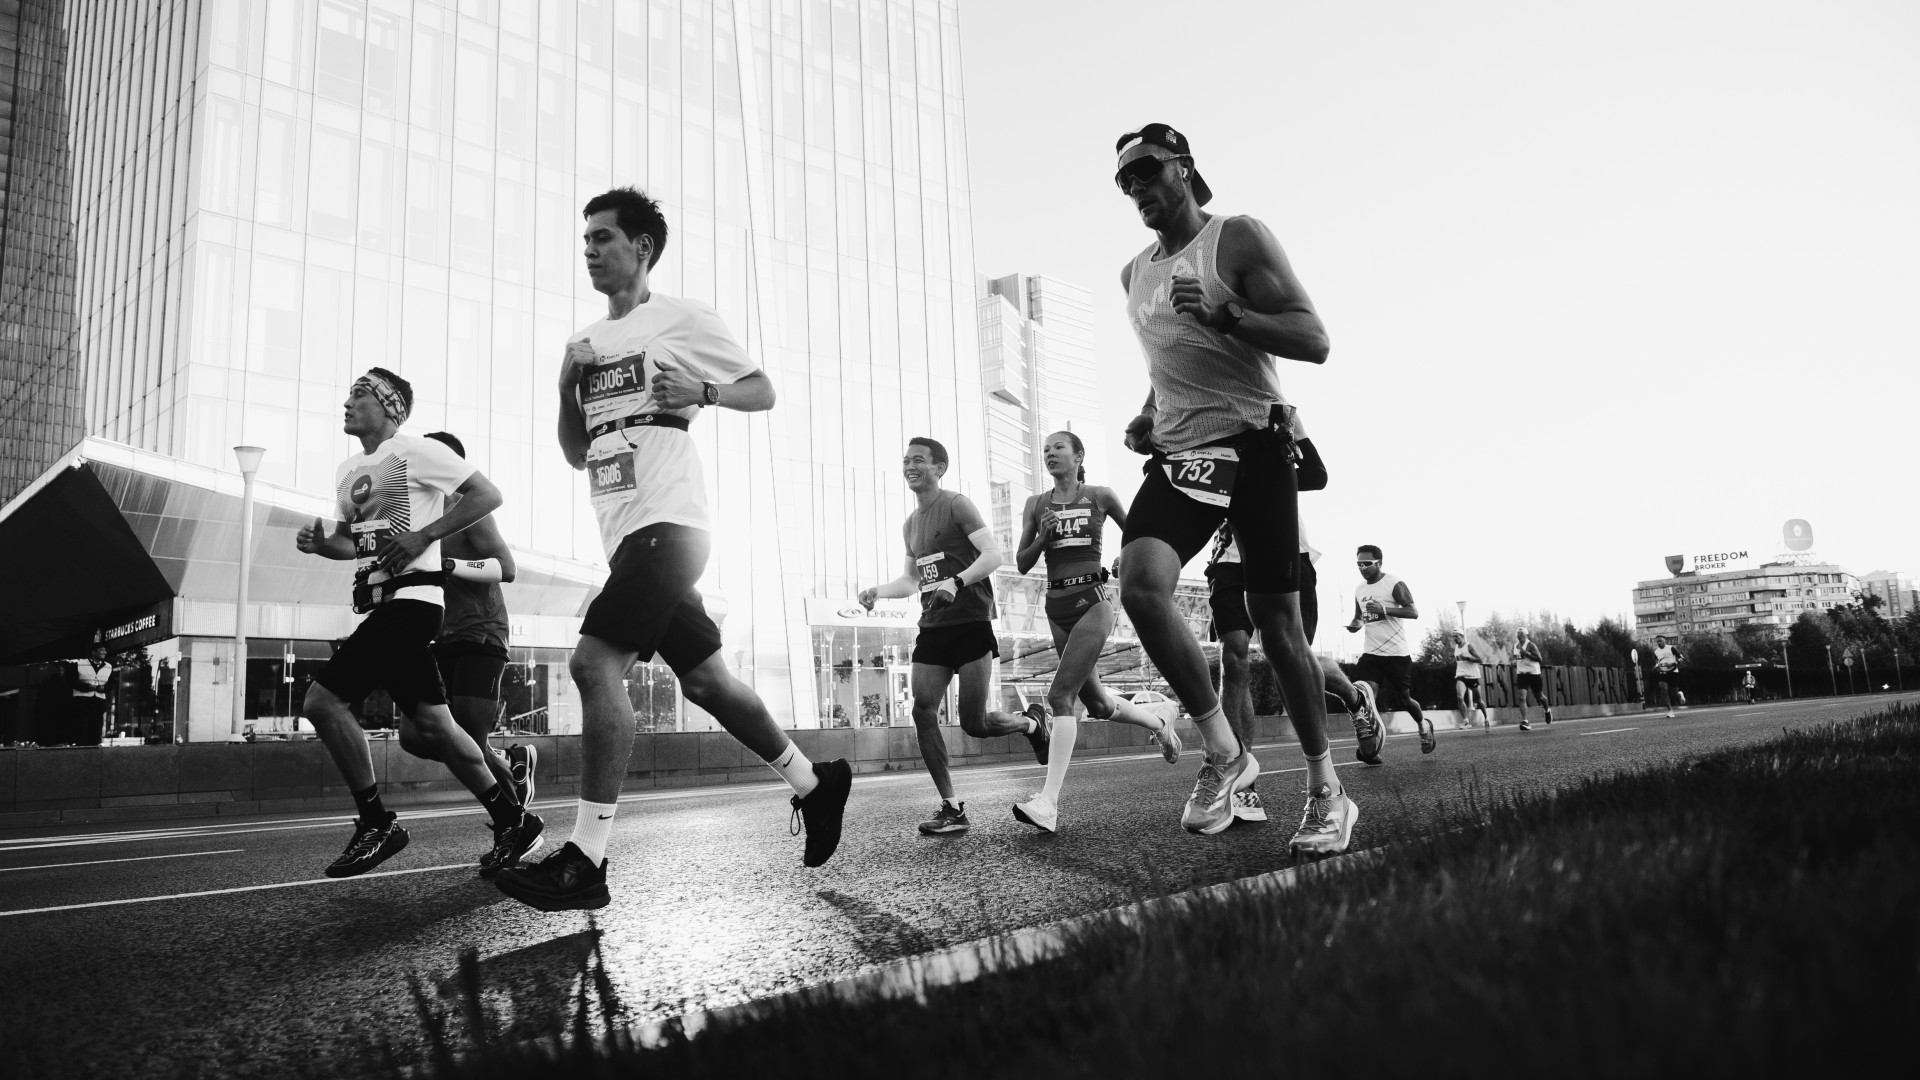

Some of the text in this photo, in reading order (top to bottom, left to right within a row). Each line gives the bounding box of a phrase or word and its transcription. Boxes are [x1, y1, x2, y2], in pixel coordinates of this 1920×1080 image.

[588, 364, 638, 394] 15006-1
[596, 462, 622, 487] 15006
[1177, 459, 1216, 485] 752
[1055, 518, 1081, 535] 444
[1693, 550, 1749, 564] FREEDOM
[1694, 562, 1727, 571] BROKER
[867, 609, 908, 619] CHERY
[105, 614, 156, 641] STARBUCKS COFFEE
[1483, 663, 1632, 708] ESETAI PARK
